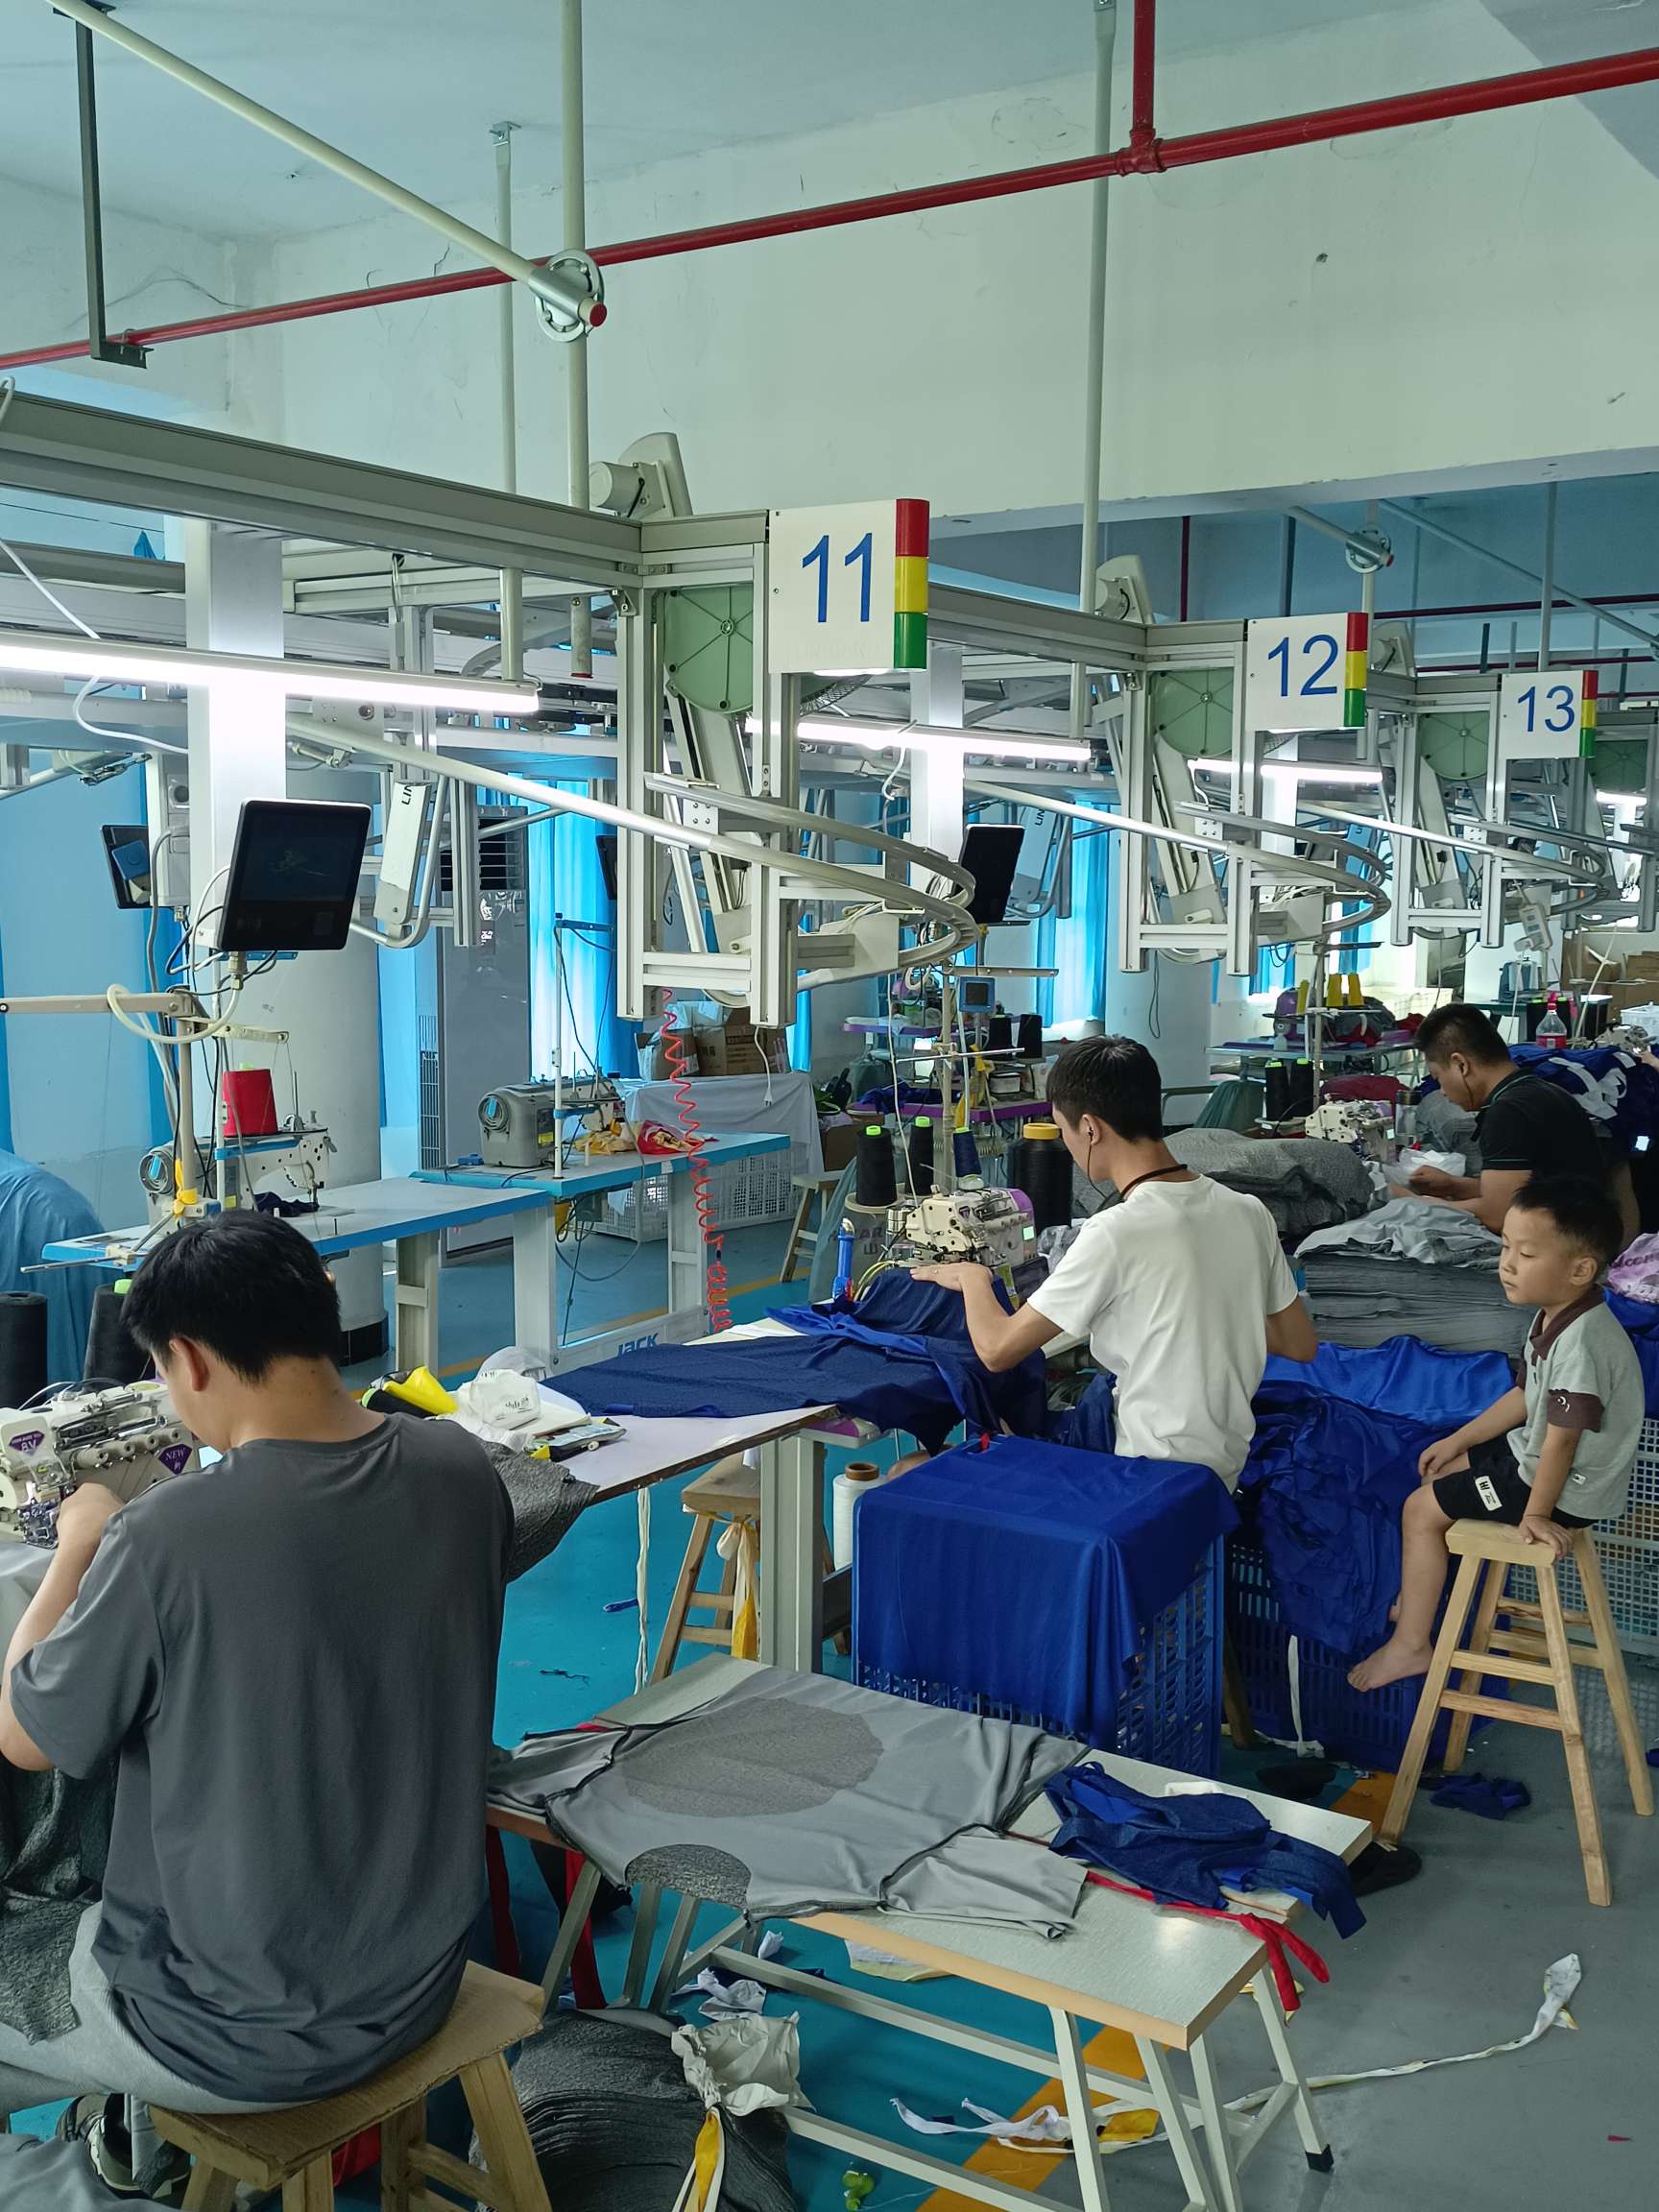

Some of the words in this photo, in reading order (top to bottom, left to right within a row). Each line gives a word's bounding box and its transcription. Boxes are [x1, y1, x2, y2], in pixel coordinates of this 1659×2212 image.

[802, 533, 873, 623] 11
[1267, 634, 1338, 697] 12
[1517, 685, 1575, 733] 13
